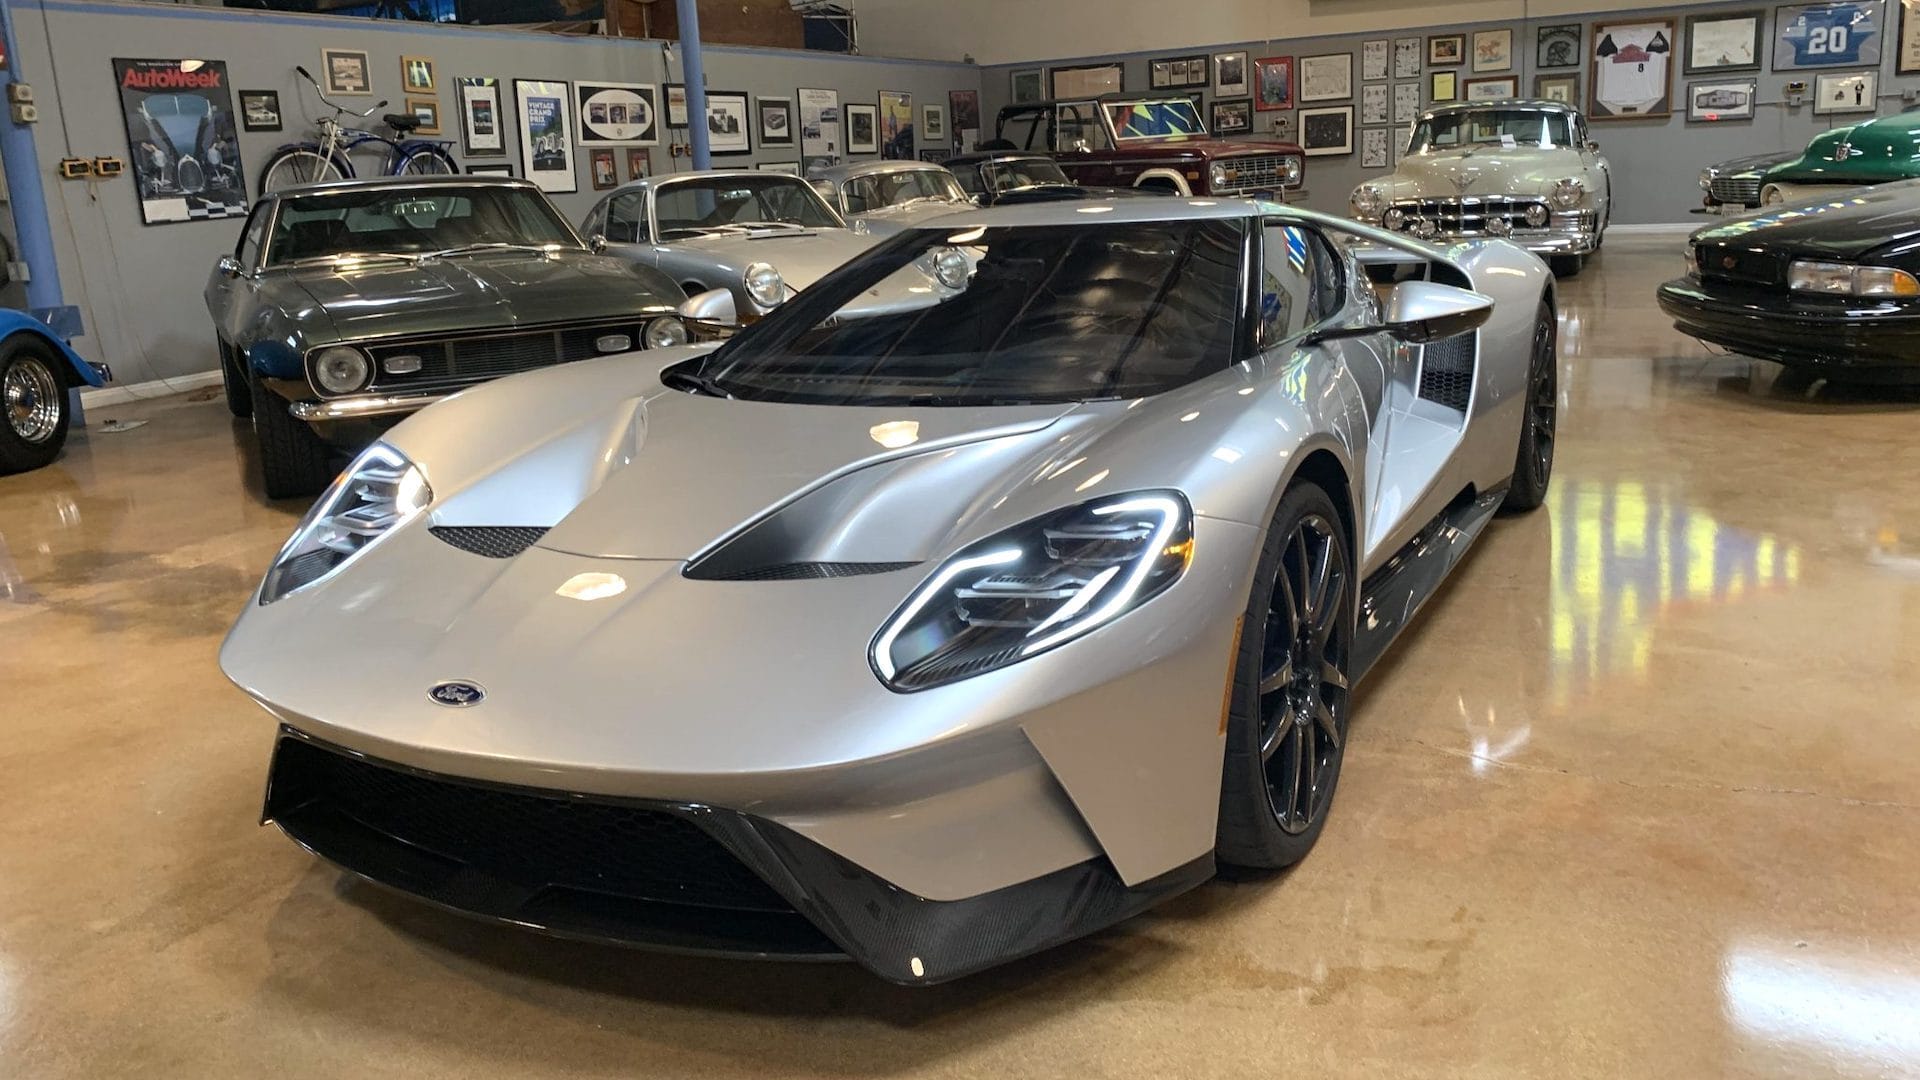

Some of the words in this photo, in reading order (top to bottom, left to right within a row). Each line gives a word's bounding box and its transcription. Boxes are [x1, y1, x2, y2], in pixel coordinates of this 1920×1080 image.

[1808, 26, 1848, 54] 20
[1638, 63, 1644, 73] 8
[123, 67, 220, 88] AutoWeek
[529, 102, 555, 110] VINTAGE
